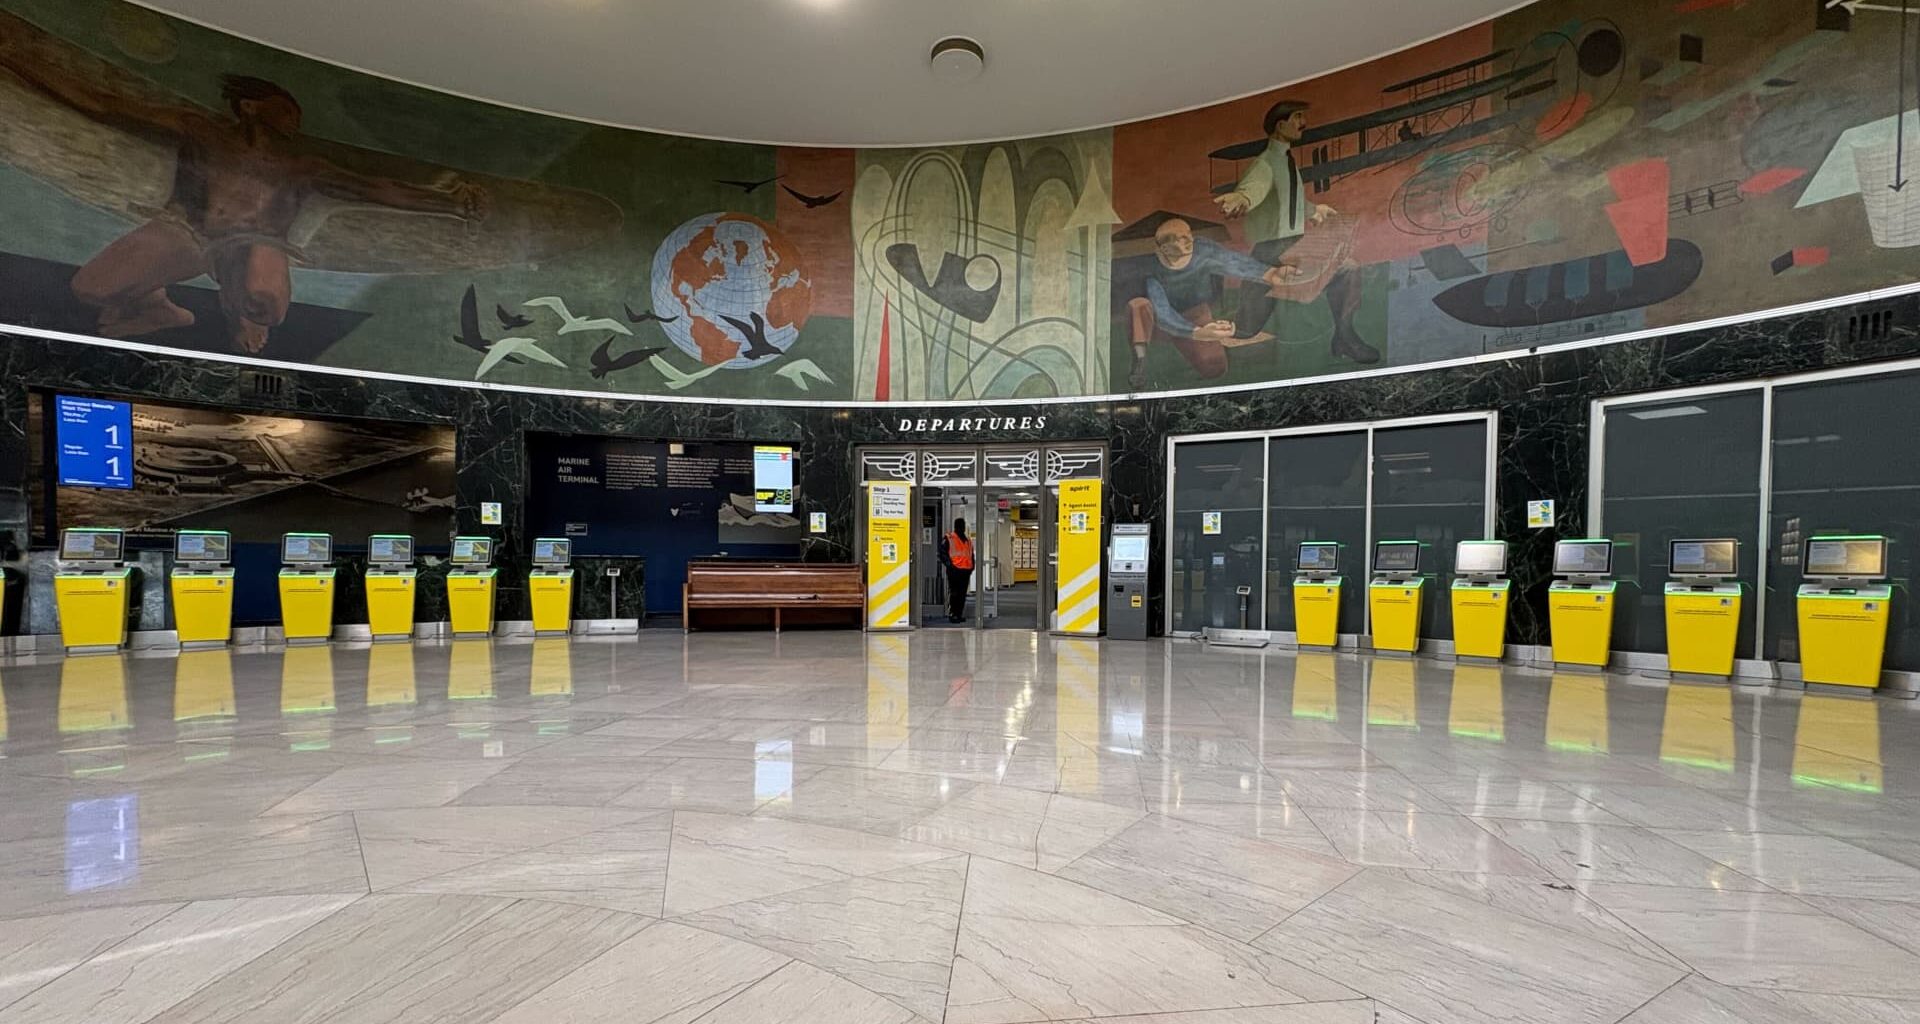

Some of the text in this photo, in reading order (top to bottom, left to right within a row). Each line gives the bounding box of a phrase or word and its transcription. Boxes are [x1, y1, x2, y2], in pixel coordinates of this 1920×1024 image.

[899, 417, 1046, 431] DEPARTURES
[105, 425, 118, 445] 1
[106, 456, 119, 476] 1
[558, 457, 590, 465] MARINE
[558, 475, 600, 483] TERMINAL
